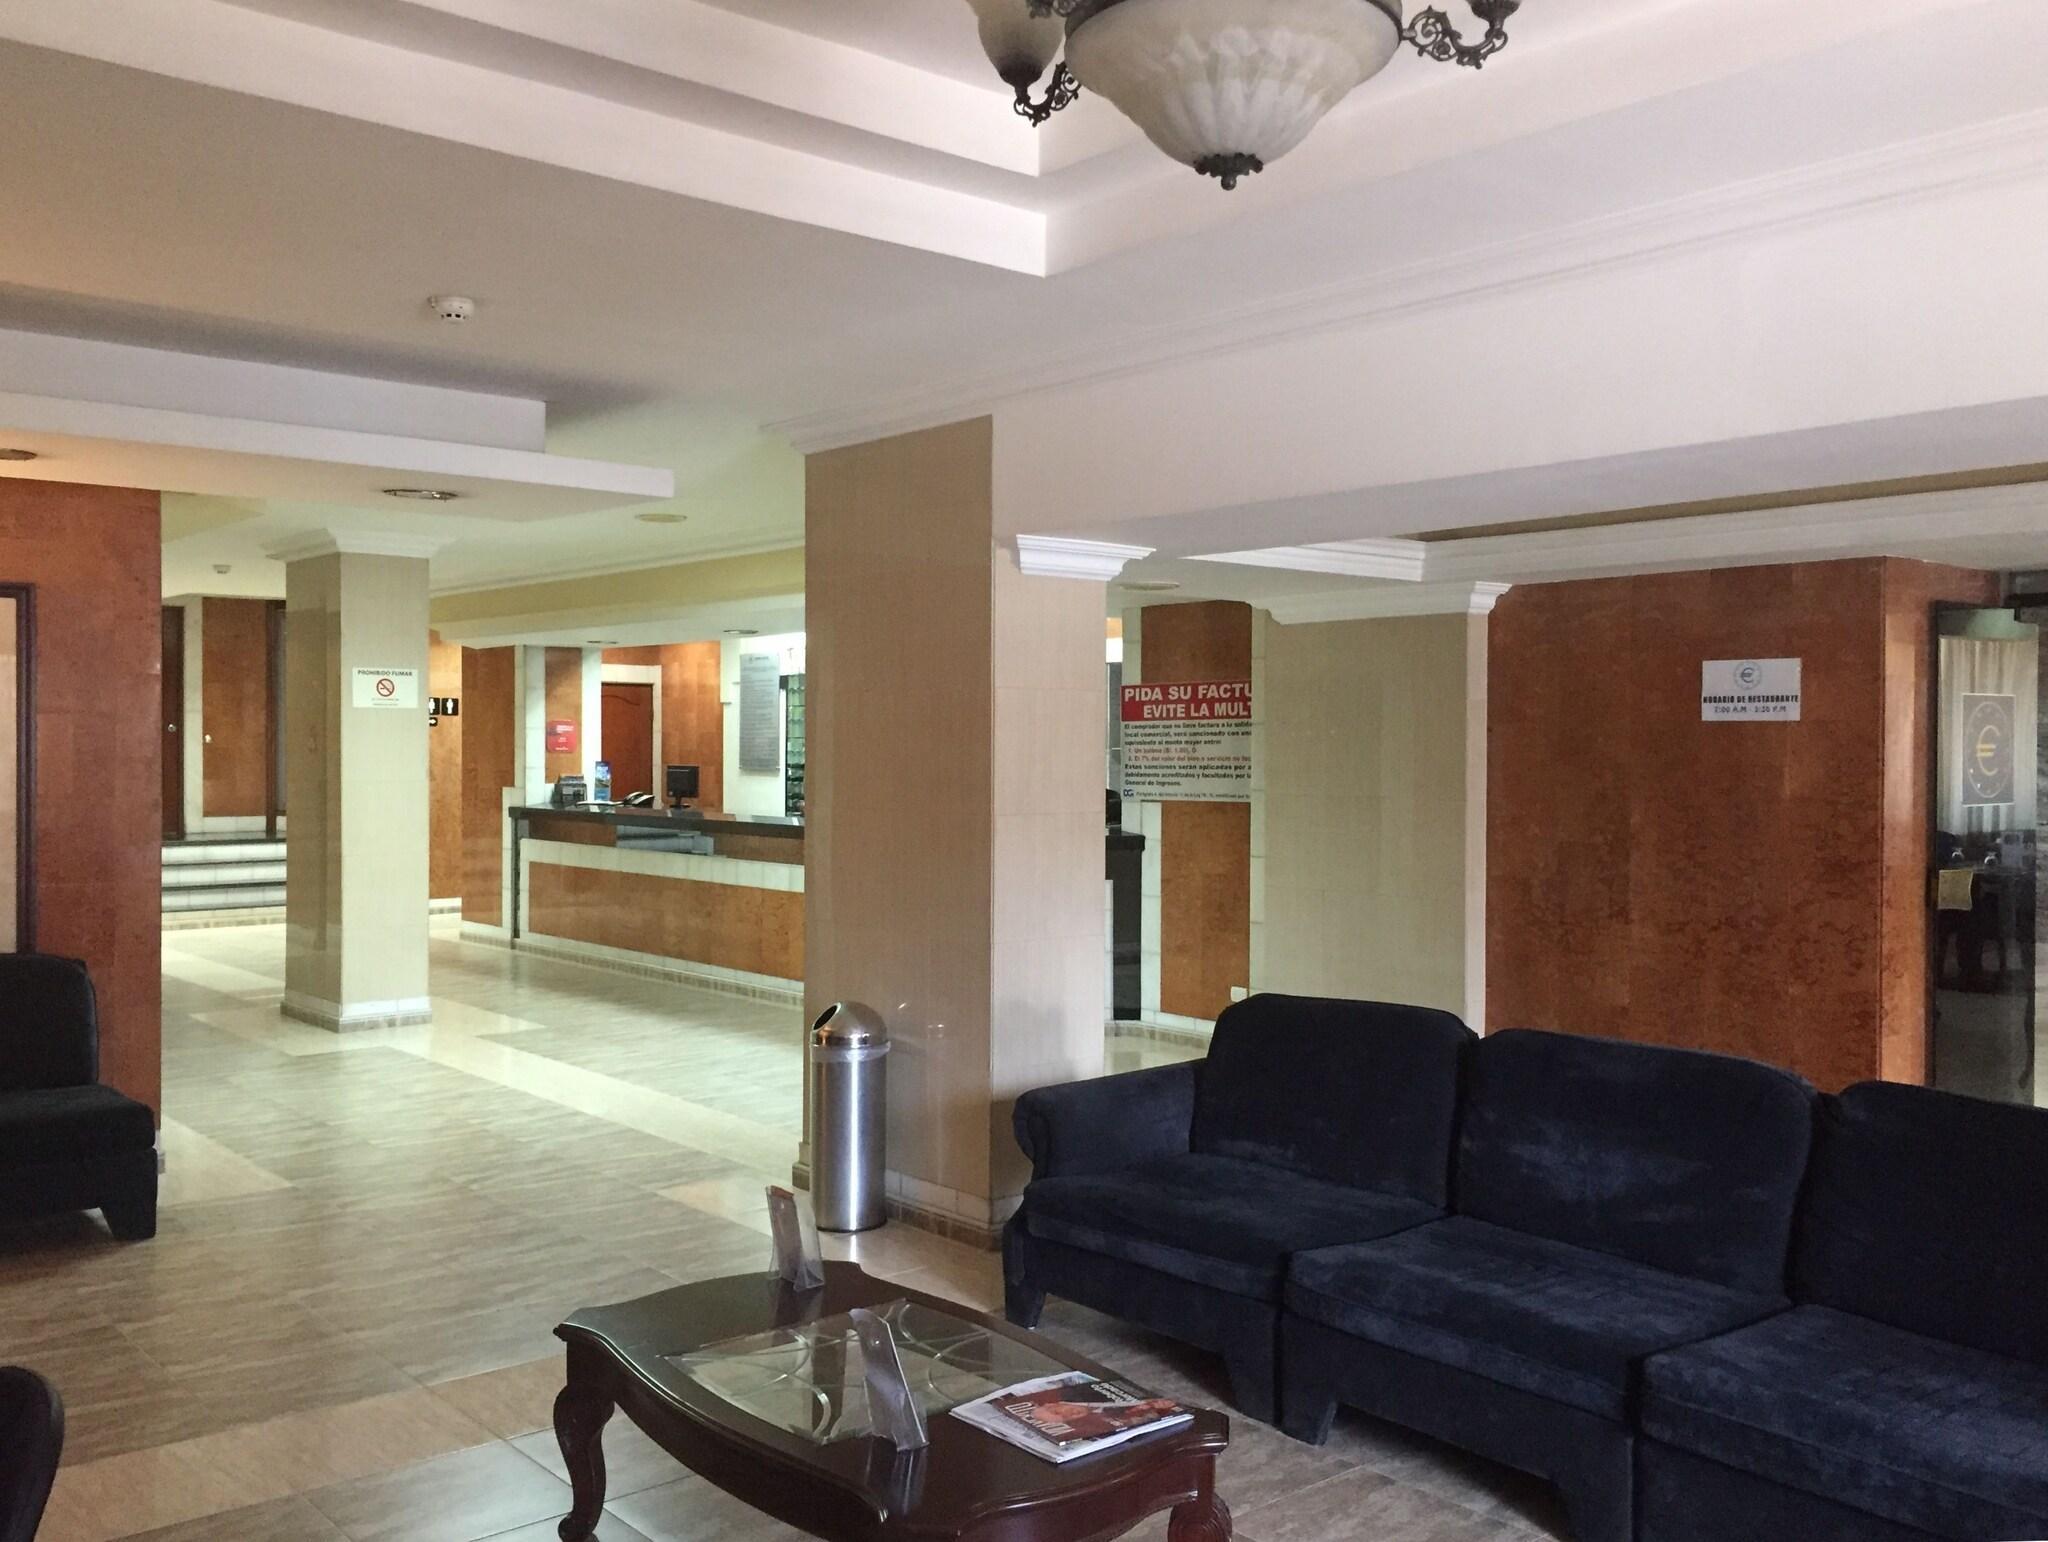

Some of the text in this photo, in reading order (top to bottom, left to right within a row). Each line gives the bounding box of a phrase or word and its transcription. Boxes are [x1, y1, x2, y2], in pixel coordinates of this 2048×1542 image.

[1124, 687, 1163, 702] PIDA
[1168, 685, 1192, 700] SU
[1703, 695, 1798, 704] HORARIO DE RESTAURANTE
[1143, 704, 1186, 719] EVITE
[1190, 703, 1210, 717] LA
